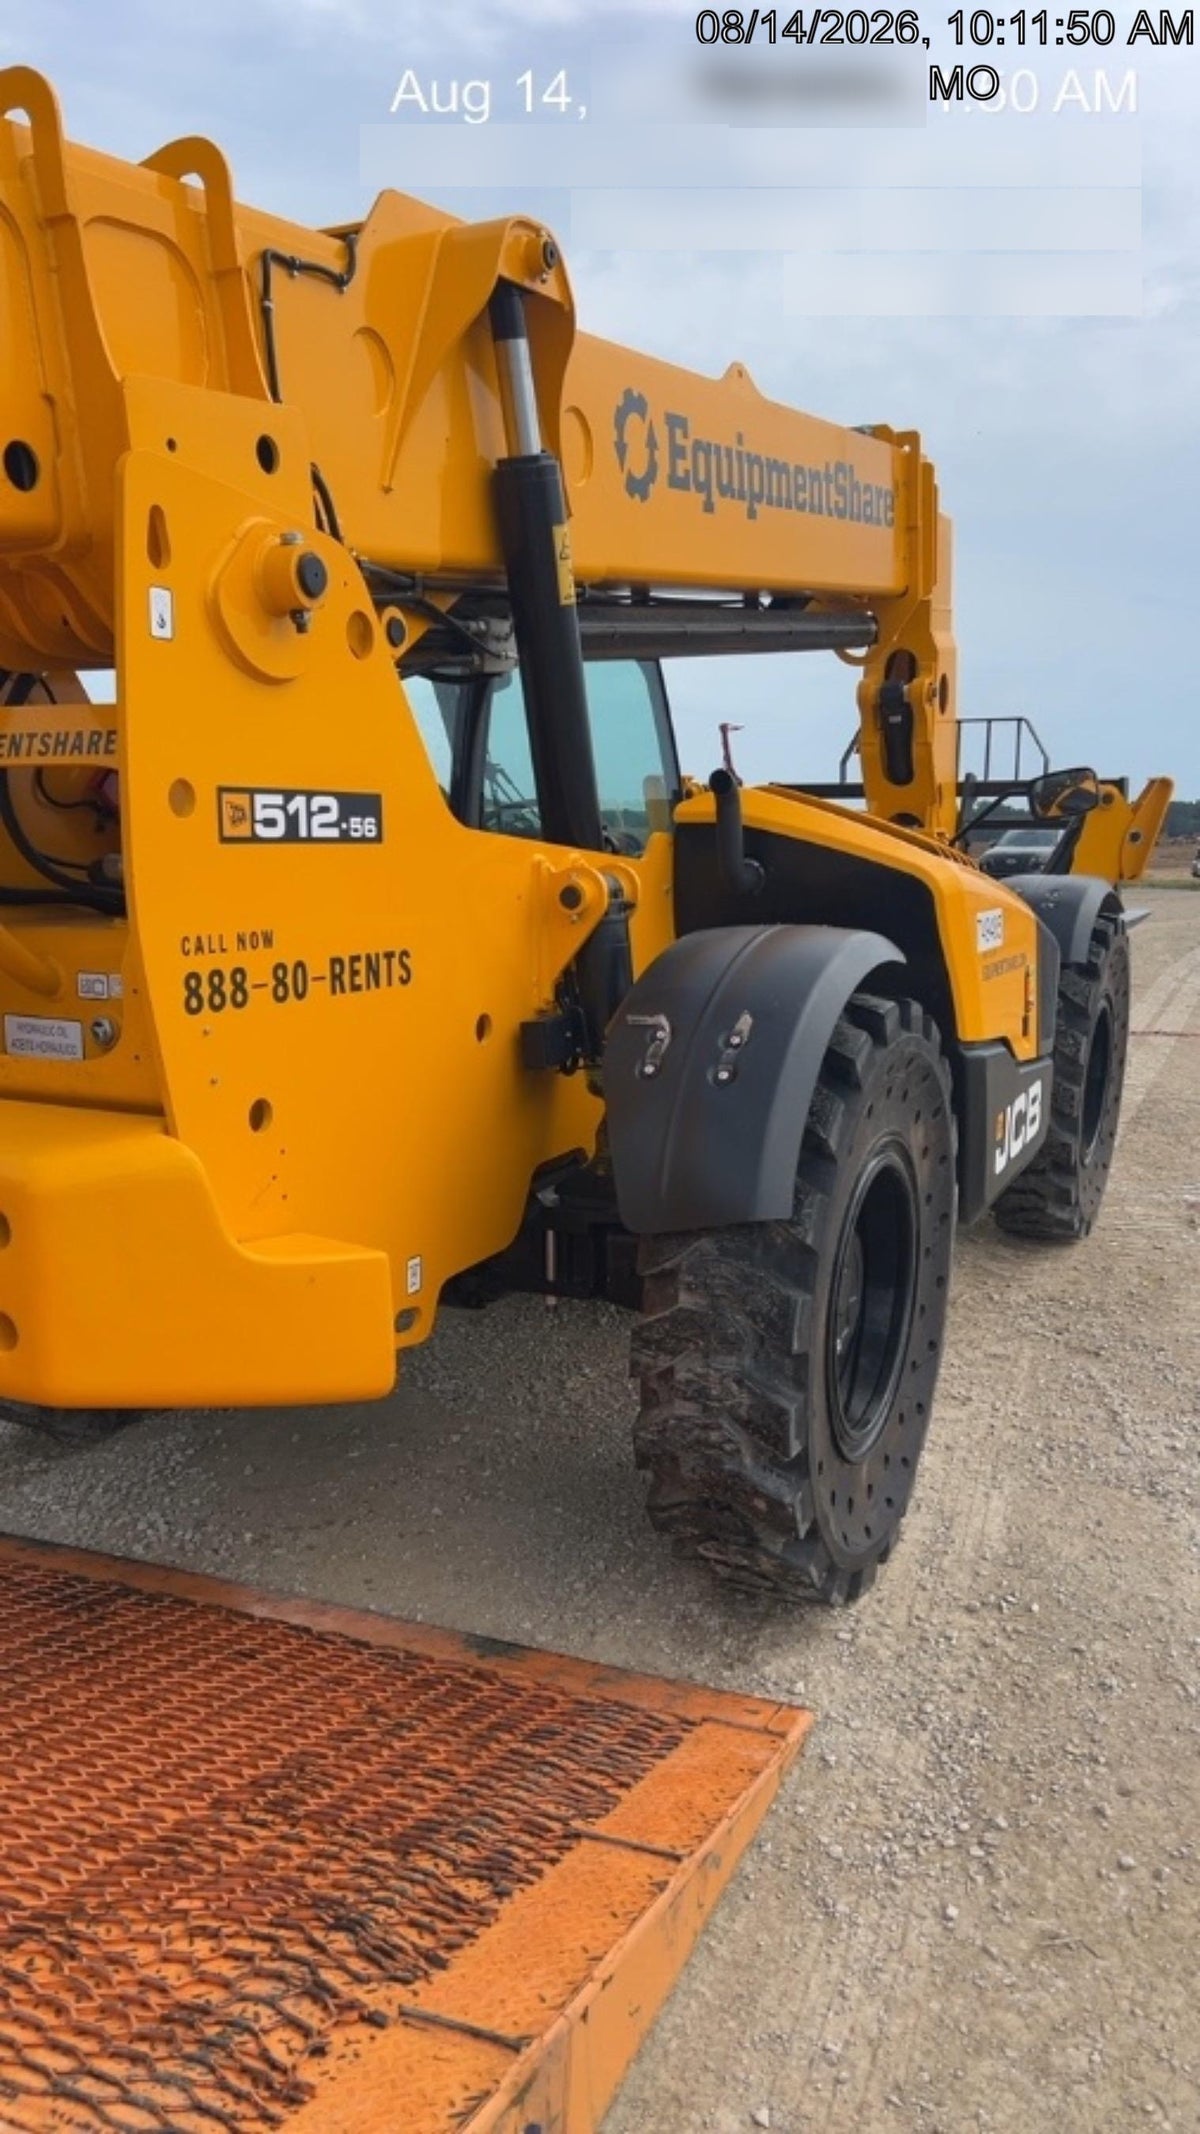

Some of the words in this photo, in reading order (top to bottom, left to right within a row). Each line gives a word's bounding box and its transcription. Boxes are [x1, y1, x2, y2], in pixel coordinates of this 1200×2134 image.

[664, 412, 893, 529] EquipmentShare
[181, 933, 228, 957] CALL
[236, 929, 274, 951] NOW
[183, 948, 412, 1016] 888-80-RENTS
[994, 1079, 1043, 1176] JCB
